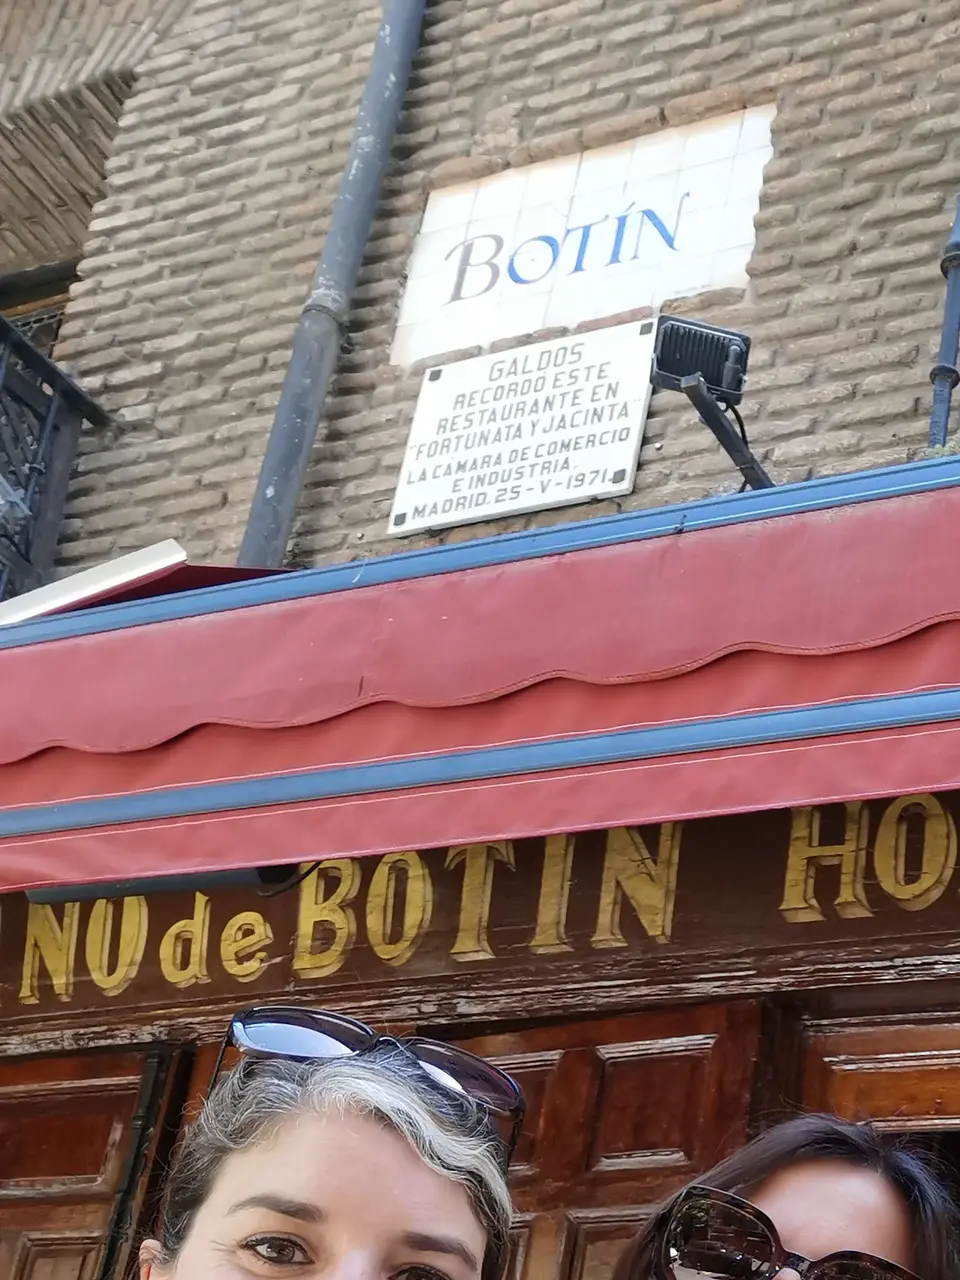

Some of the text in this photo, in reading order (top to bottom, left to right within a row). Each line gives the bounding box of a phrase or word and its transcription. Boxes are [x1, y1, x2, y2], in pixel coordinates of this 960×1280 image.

[441, 191, 690, 306] BOTÍN
[488, 342, 585, 382] GALDOS
[552, 361, 611, 389] ESTE
[436, 381, 620, 436] RESTAURANTE EN
[530, 418, 541, 437] Y
[406, 467, 428, 485] LA
[508, 446, 532, 464] DE
[534, 427, 631, 459] COMERCIO
[452, 478, 465, 493] E
[158, 891, 274, 988] de
